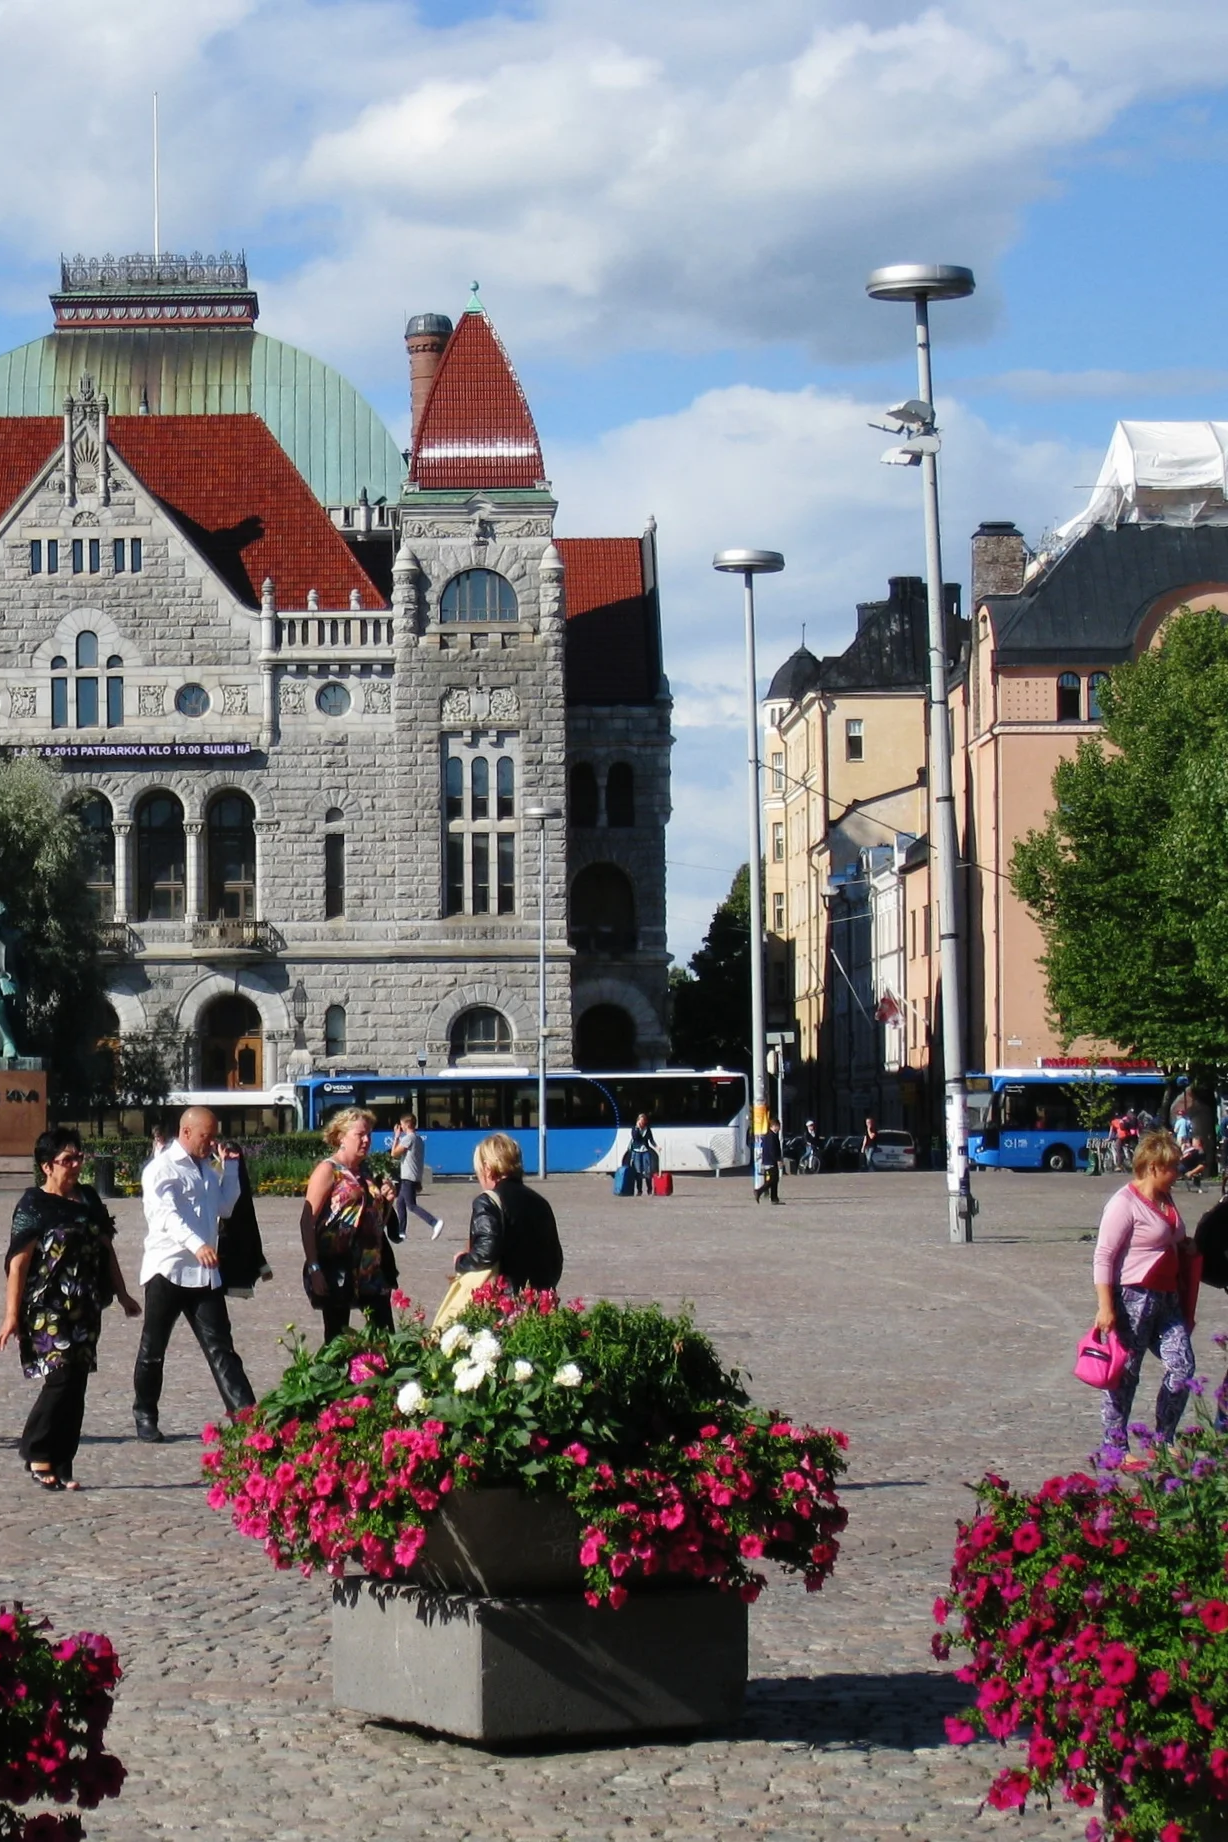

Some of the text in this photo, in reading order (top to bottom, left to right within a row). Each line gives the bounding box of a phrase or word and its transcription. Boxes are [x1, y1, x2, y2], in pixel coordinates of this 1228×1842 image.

[80, 746, 146, 756] PATRIARKKA
[148, 746, 171, 756] KLO
[174, 745, 200, 755] 19.00
[202, 745, 234, 755] SUURI
